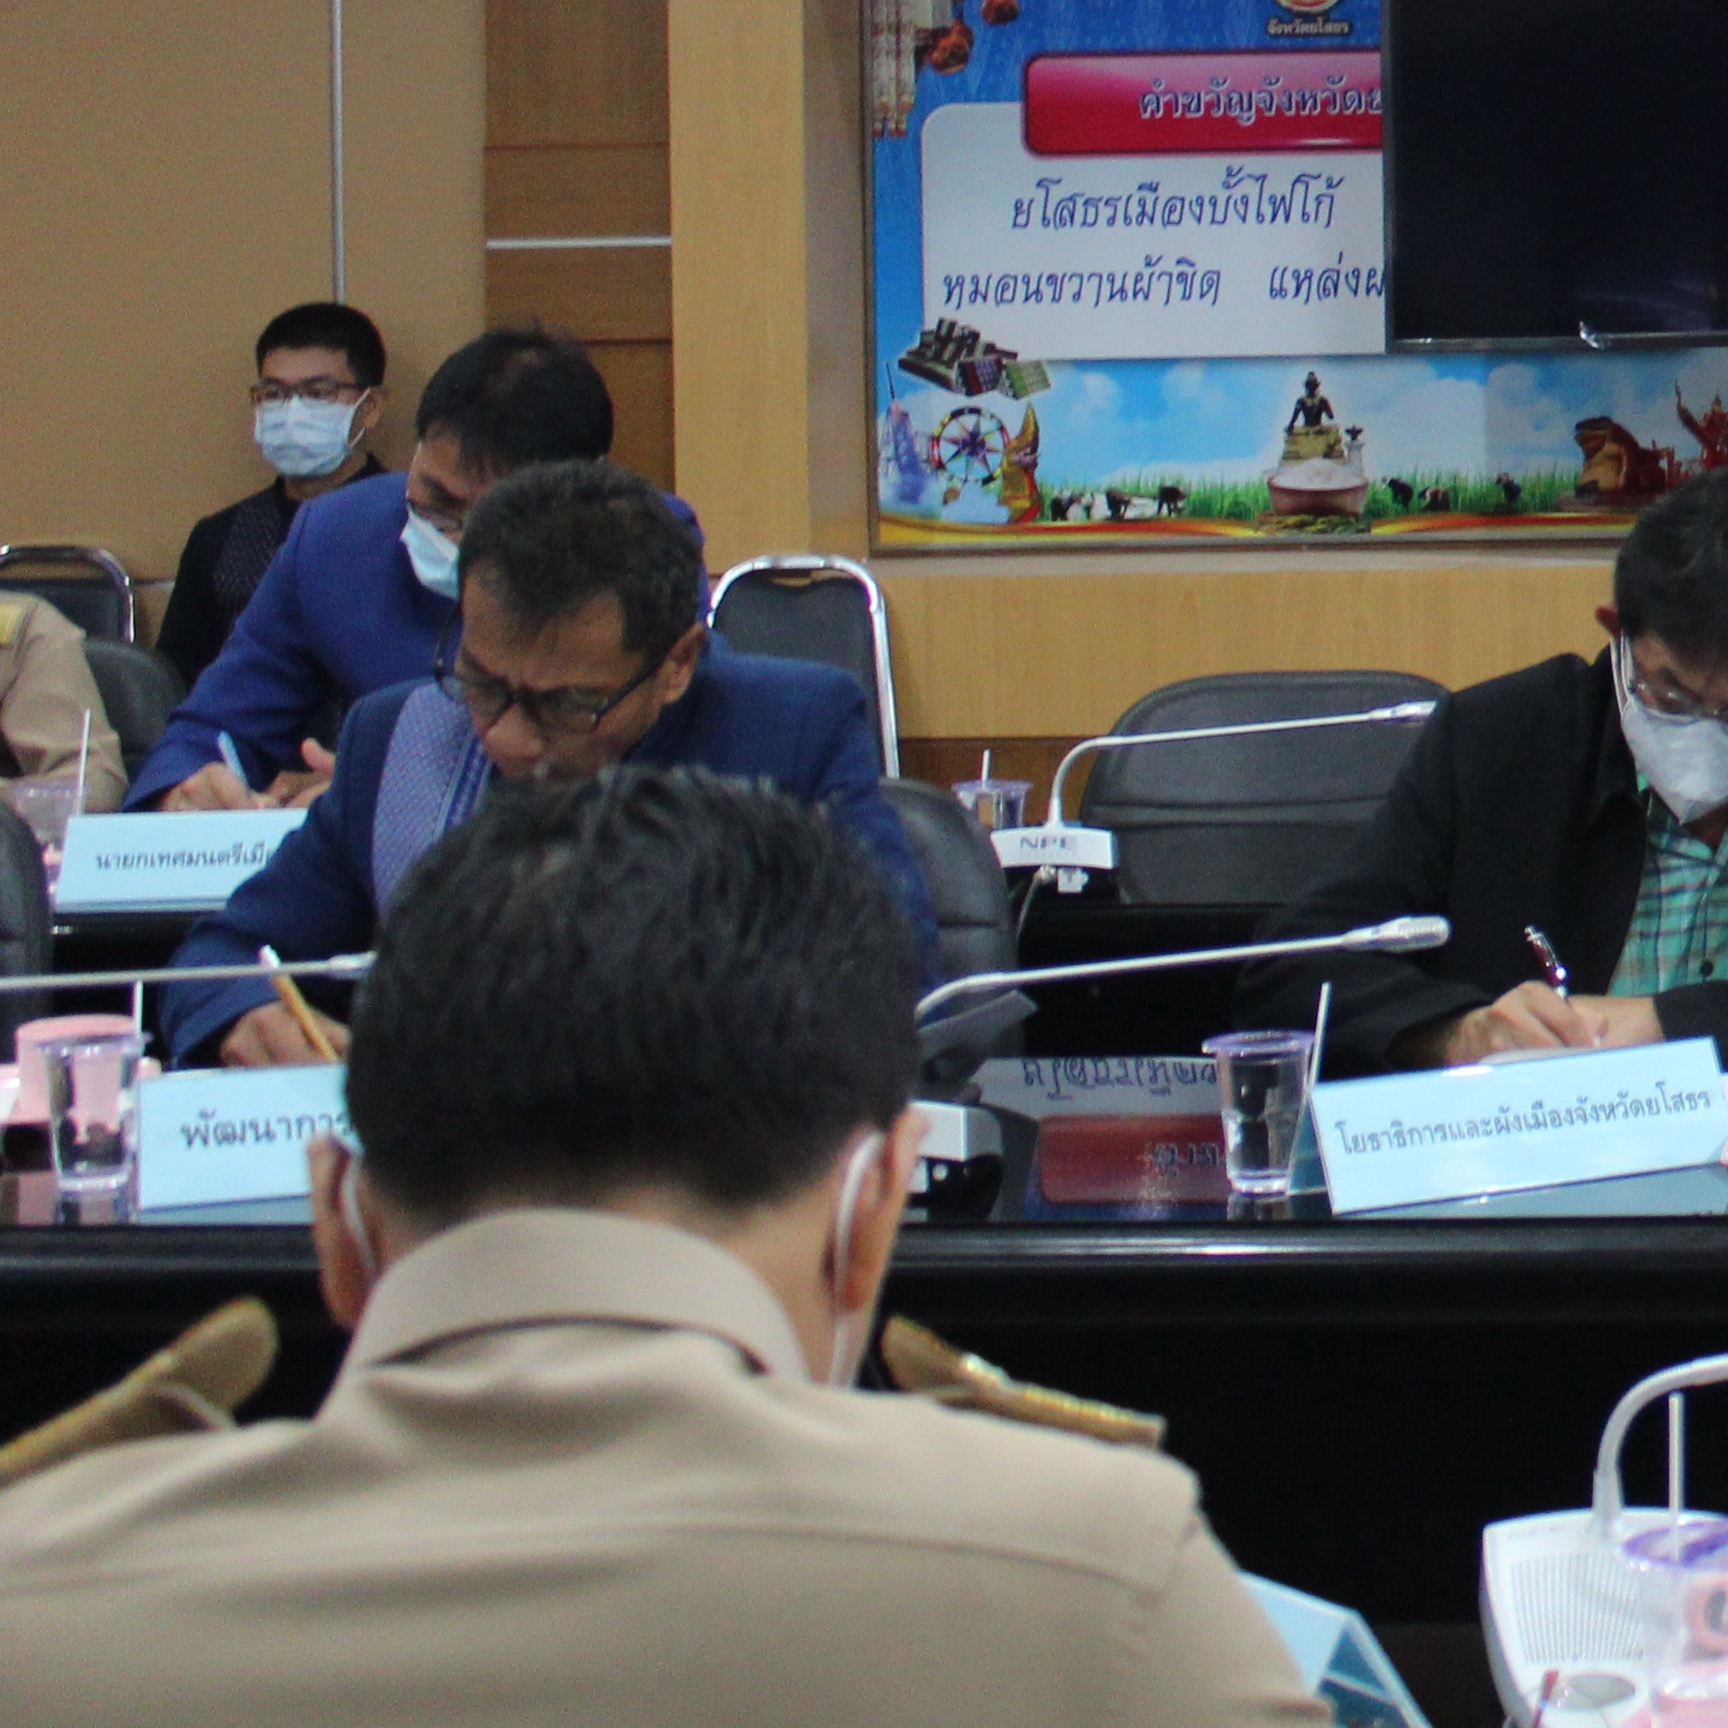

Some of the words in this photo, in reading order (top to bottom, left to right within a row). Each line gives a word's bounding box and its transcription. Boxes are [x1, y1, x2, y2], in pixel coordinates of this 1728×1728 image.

[1140, 74, 1383, 125] คำขวัญจังหวัดย
[1011, 165, 1344, 231] ยโสธรเมืองบั้งไฟโก้
[943, 255, 1223, 309] หมอนขวานผ้าขิด
[1268, 251, 1384, 306] แหล่งผ
[1335, 1080, 1712, 1156] โยธาธิการและผังเมืองจังหวัดยโสธร
